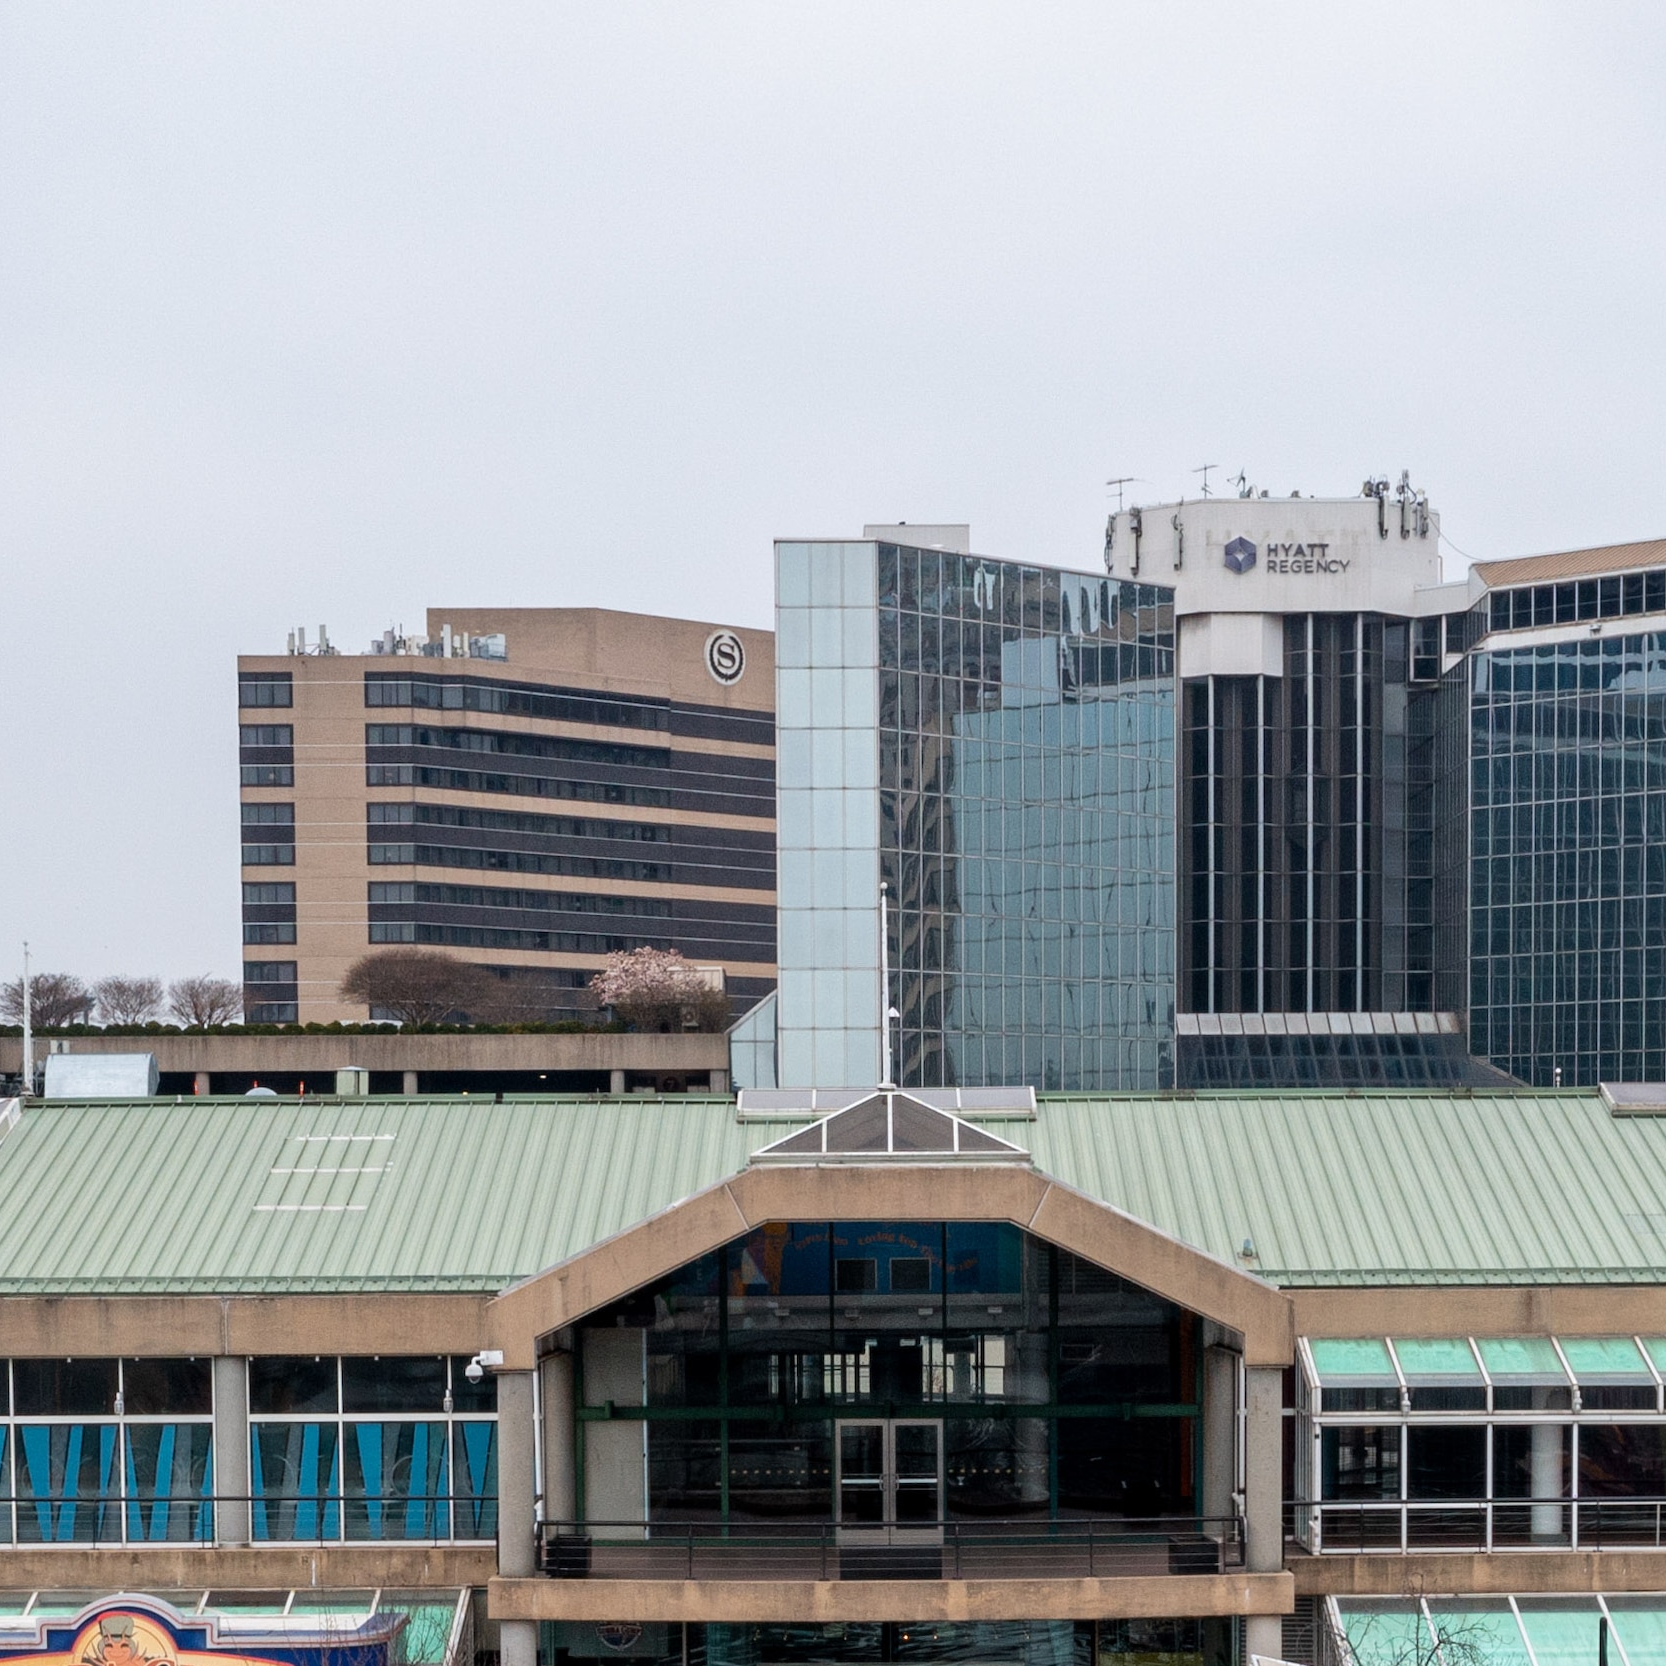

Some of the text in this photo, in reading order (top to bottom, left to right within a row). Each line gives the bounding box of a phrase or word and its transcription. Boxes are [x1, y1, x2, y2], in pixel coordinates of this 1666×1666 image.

[1267, 543, 1329, 557] HYATT
[1267, 559, 1351, 574] REGENCY
[717, 642, 736, 669] S
